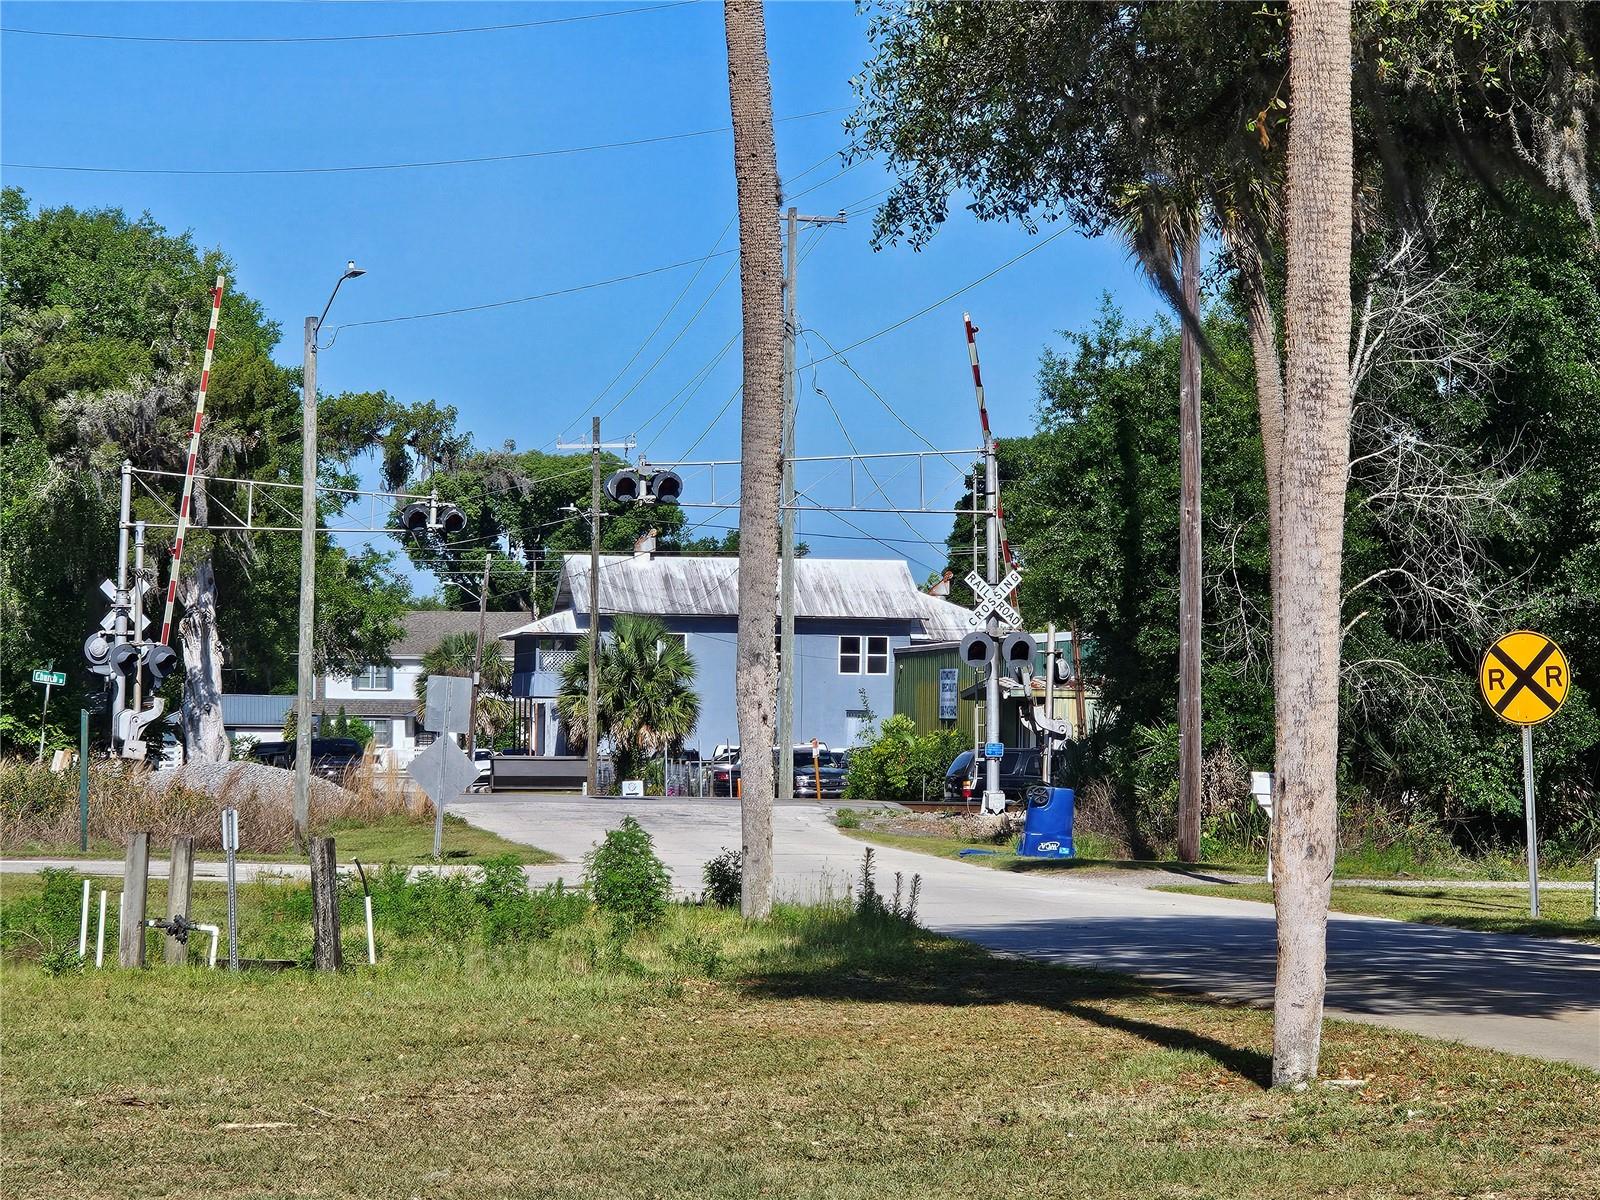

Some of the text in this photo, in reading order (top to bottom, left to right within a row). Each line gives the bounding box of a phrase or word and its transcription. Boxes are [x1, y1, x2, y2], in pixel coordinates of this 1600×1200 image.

[968, 572, 1020, 626] CROSSING
[968, 573, 1021, 626] RAIL ROAD
[35, 671, 58, 683] Church
[1488, 666, 1562, 690] R R
